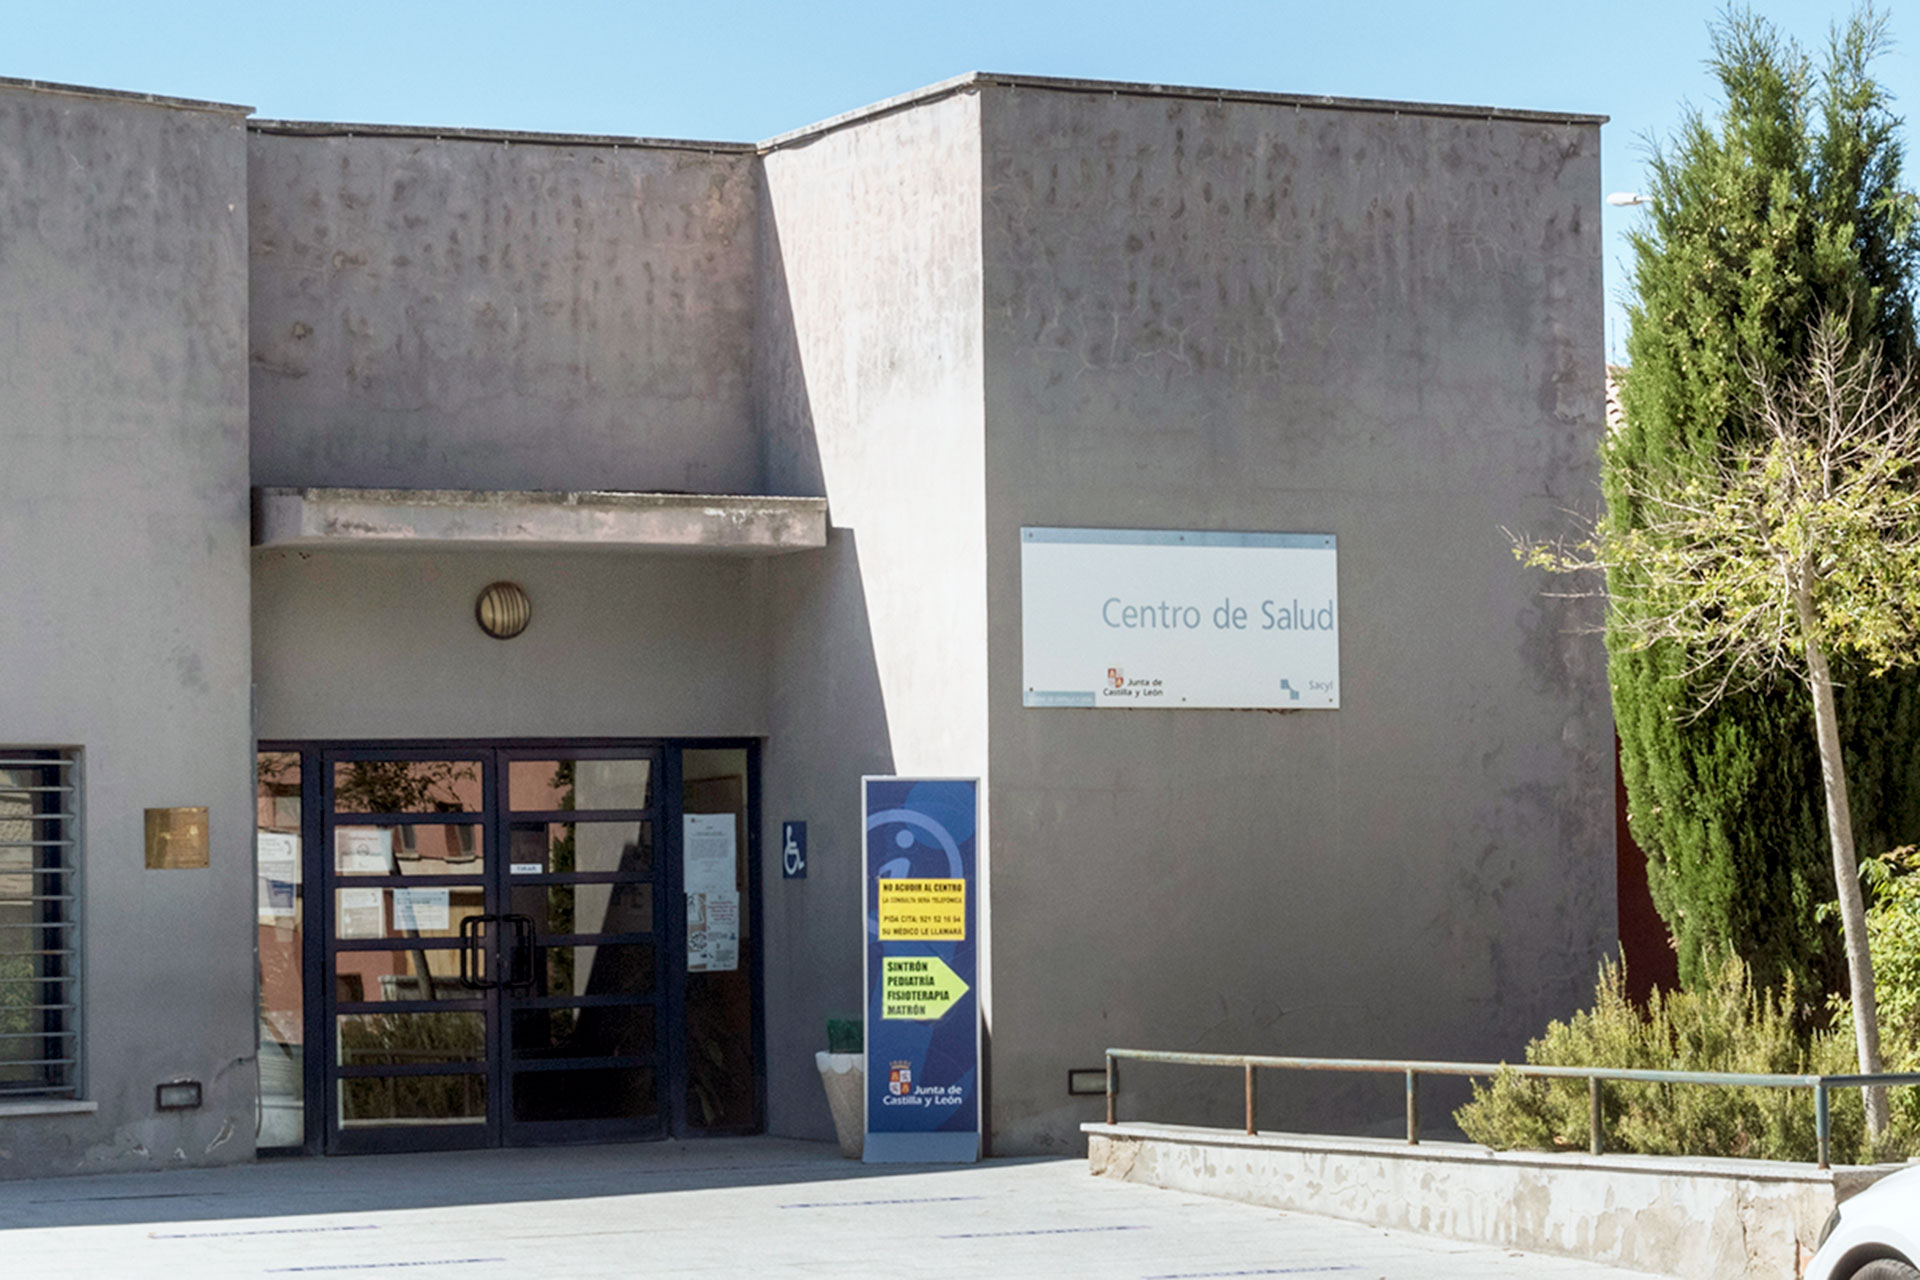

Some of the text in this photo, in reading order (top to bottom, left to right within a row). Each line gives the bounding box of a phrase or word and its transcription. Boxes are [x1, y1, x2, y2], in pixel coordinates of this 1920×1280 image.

[1102, 597, 1334, 630] Centro de Salud
[1128, 678, 1163, 687] Junta de
[1309, 680, 1333, 693] Sacyl
[1103, 688, 1164, 699] Castilla y León
[883, 883, 963, 892] NO ACUDIR AL CENTRO
[882, 896, 889, 904] LA
[891, 896, 916, 904] CONSULTA
[884, 915, 899, 923] PIDA
[882, 927, 891, 936] SU
[920, 927, 929, 936] LE
[887, 960, 928, 972] SINTRÓN
[887, 975, 935, 986] PEDIATRÍA
[887, 990, 950, 1001] FISIOTERAPIA
[887, 1004, 926, 1015] MATRÓN
[914, 1085, 963, 1095] Junta de
[882, 1095, 963, 1108] Castilla y León
